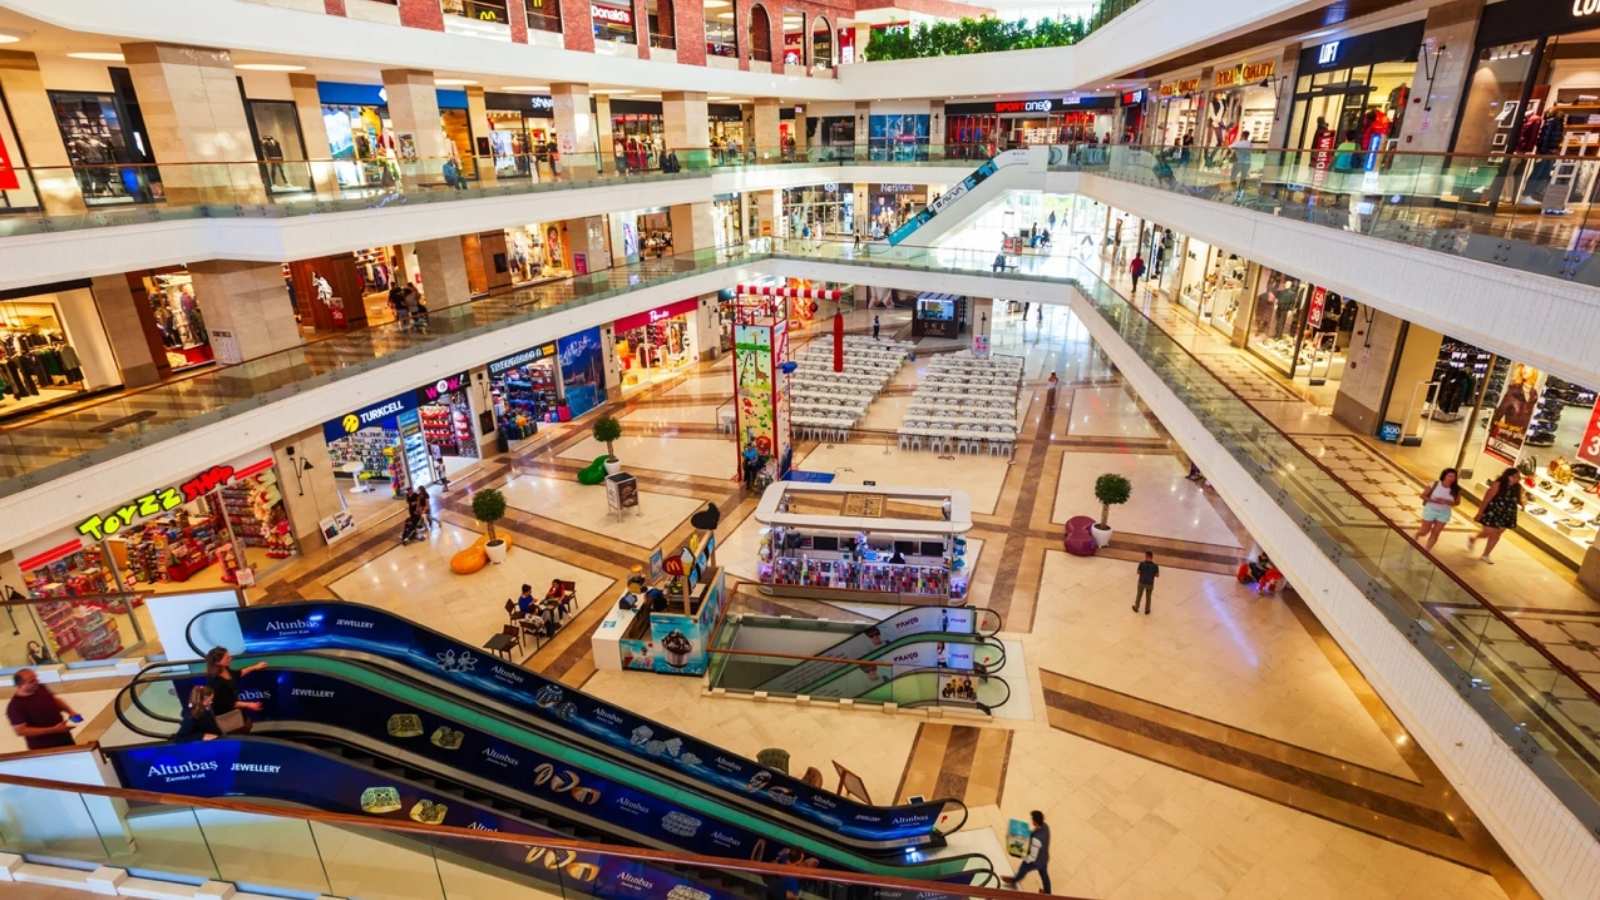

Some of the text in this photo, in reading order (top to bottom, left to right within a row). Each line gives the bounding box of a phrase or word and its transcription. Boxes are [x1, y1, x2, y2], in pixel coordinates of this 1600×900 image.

[1318, 41, 1340, 65] LOFT
[360, 401, 404, 424] TURKCELL
[336, 618, 375, 629] JEWELLERY
[291, 688, 335, 698] JEWELLERY
[230, 762, 281, 773] JEWELLERY
